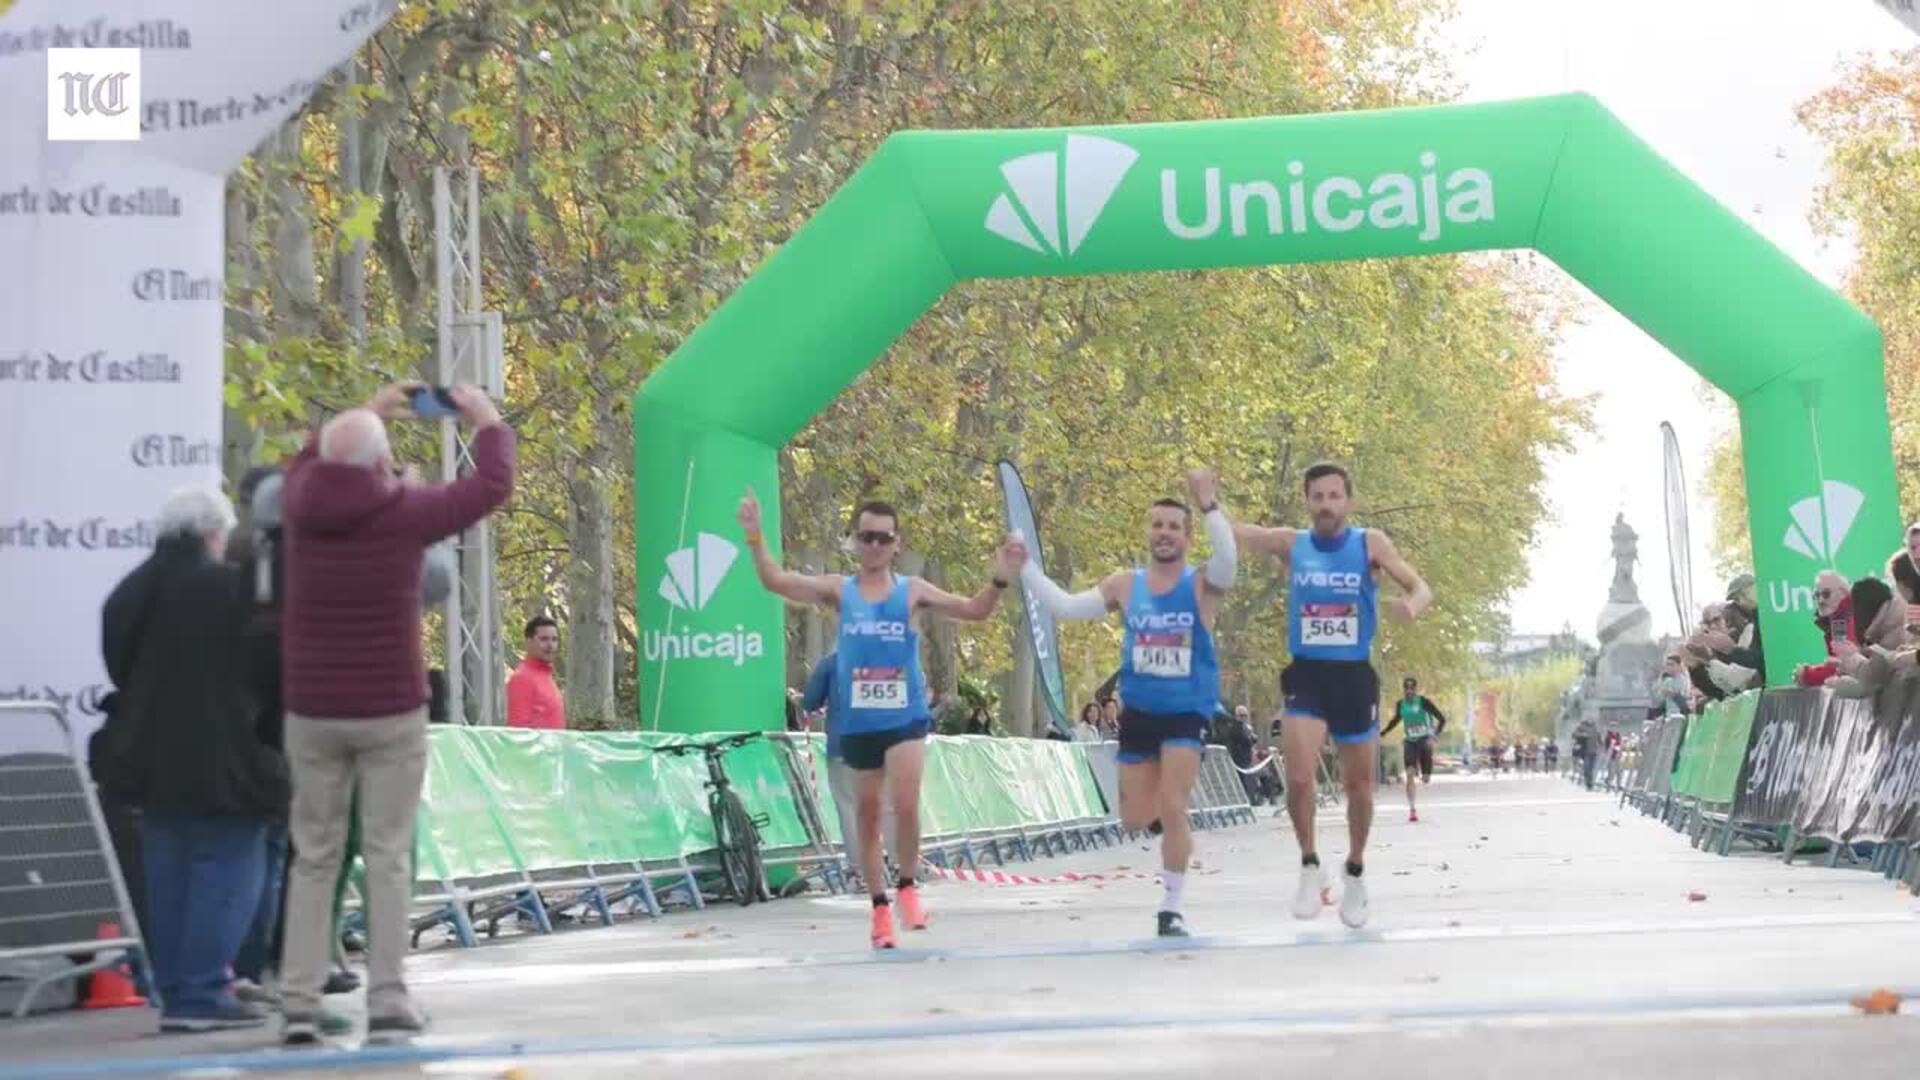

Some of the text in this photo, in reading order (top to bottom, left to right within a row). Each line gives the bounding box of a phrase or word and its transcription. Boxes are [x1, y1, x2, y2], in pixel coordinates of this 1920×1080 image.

[79, 182, 182, 217] Castilla
[1161, 151, 1495, 241] Unicaja
[79, 351, 181, 383] Castilla
[1309, 619, 1348, 637] 564
[644, 624, 763, 667] Unicaja
[860, 683, 898, 700] 565
